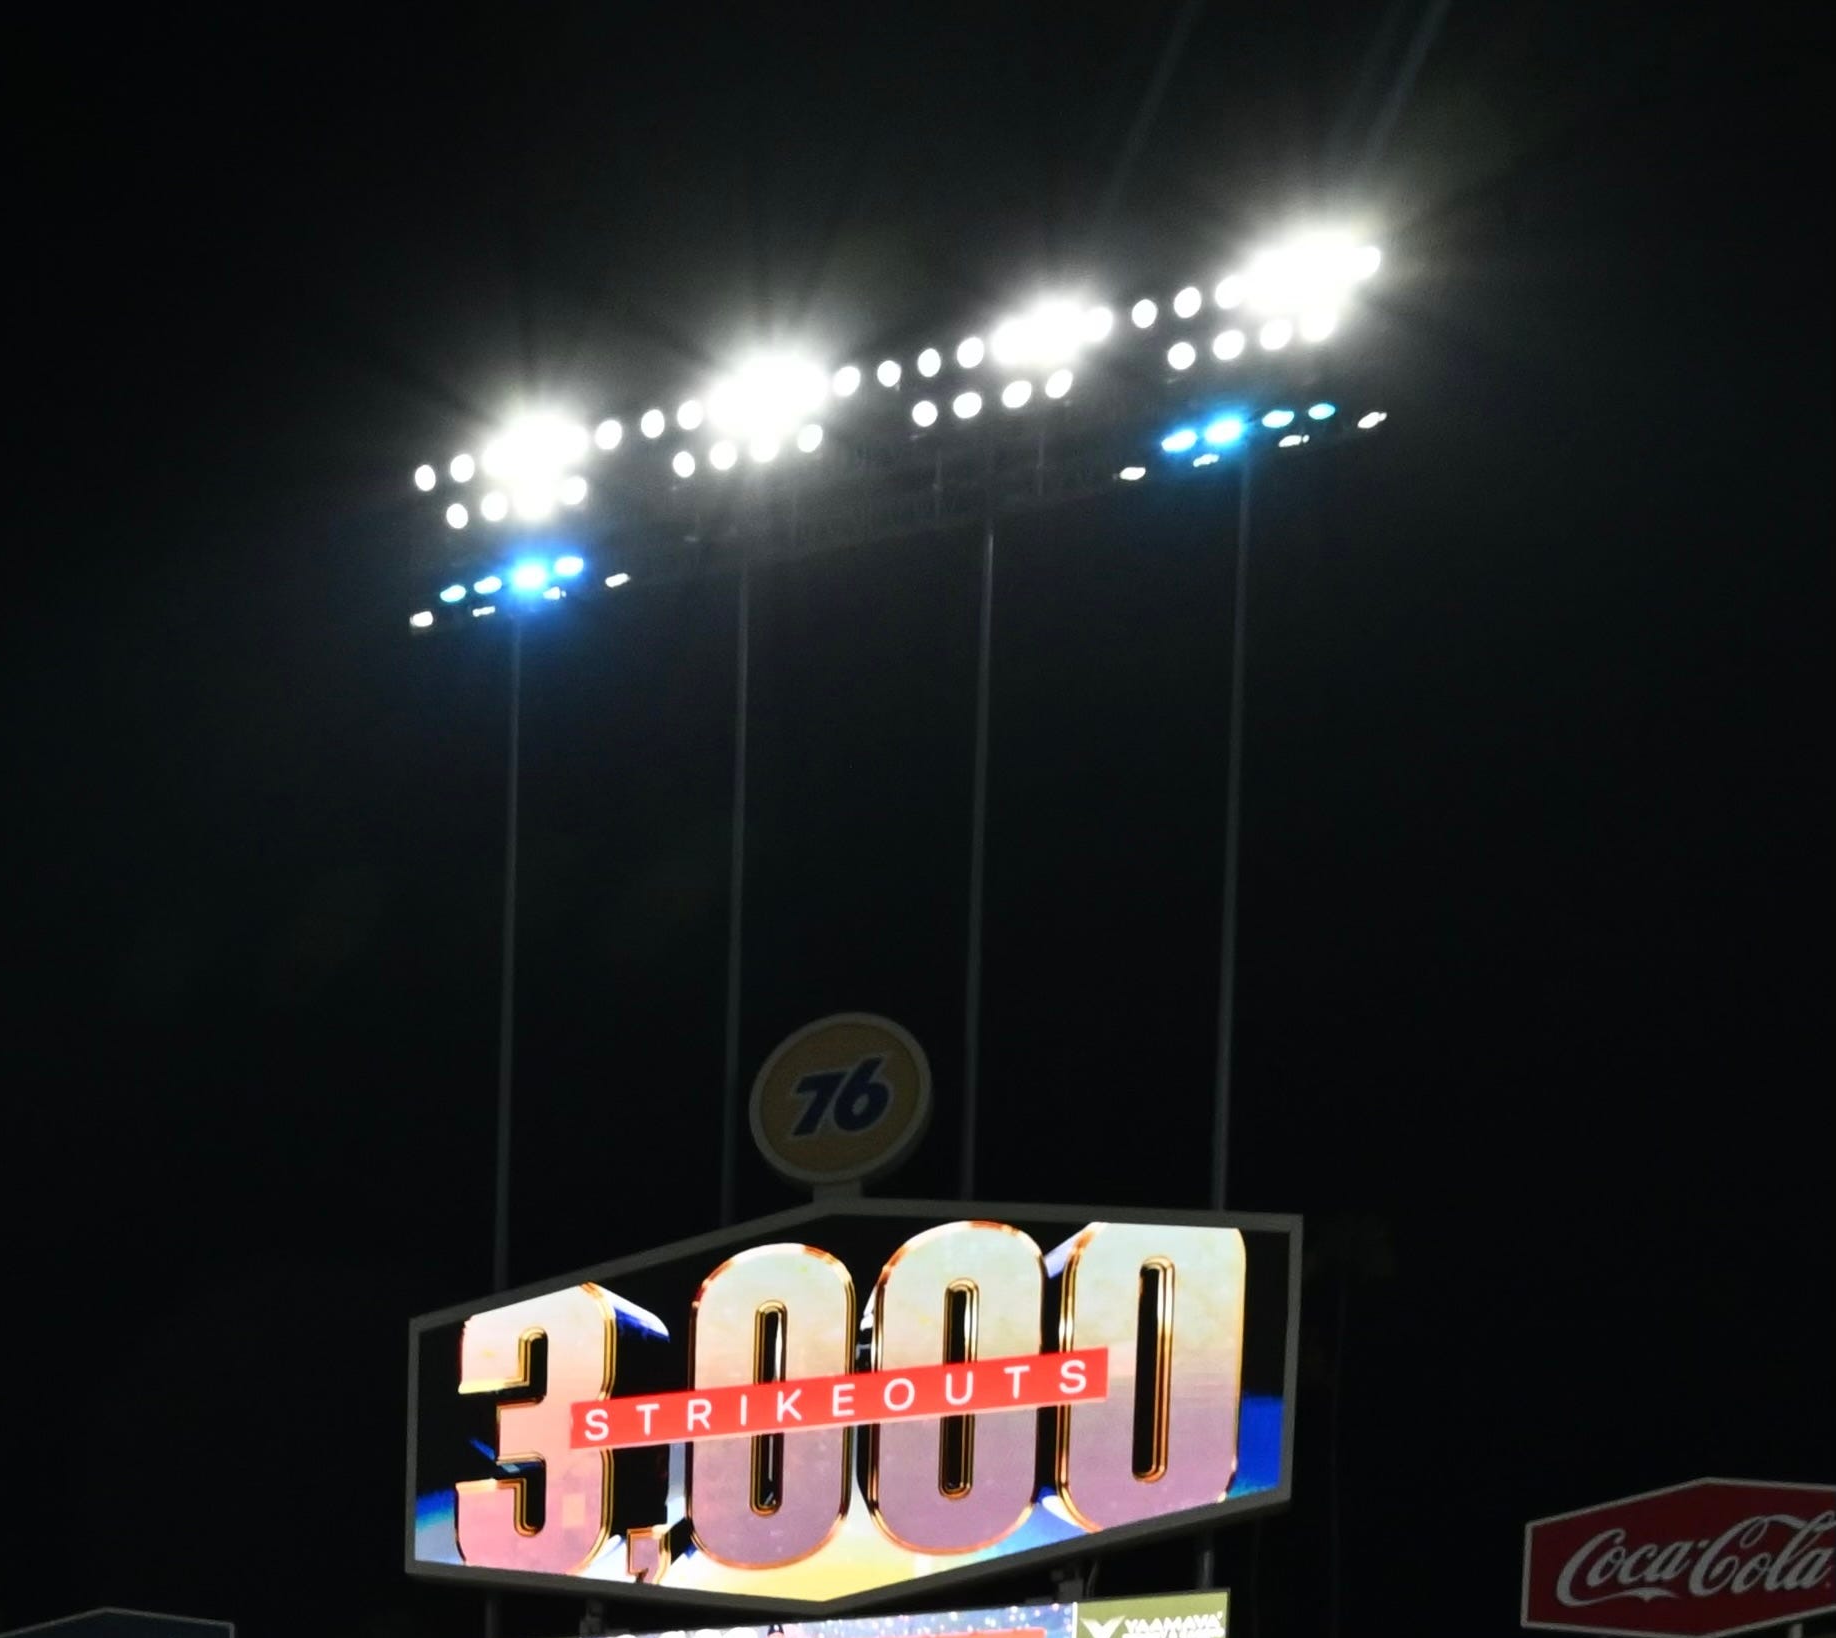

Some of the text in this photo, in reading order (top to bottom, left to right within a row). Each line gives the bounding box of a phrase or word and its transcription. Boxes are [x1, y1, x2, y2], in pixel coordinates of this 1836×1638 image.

[791, 1055, 892, 1138] 76
[454, 1219, 1247, 1586] 3,000
[583, 1359, 1089, 1444] STRIKEOUTS
[1555, 1510, 1836, 1607] Coca-Cola
